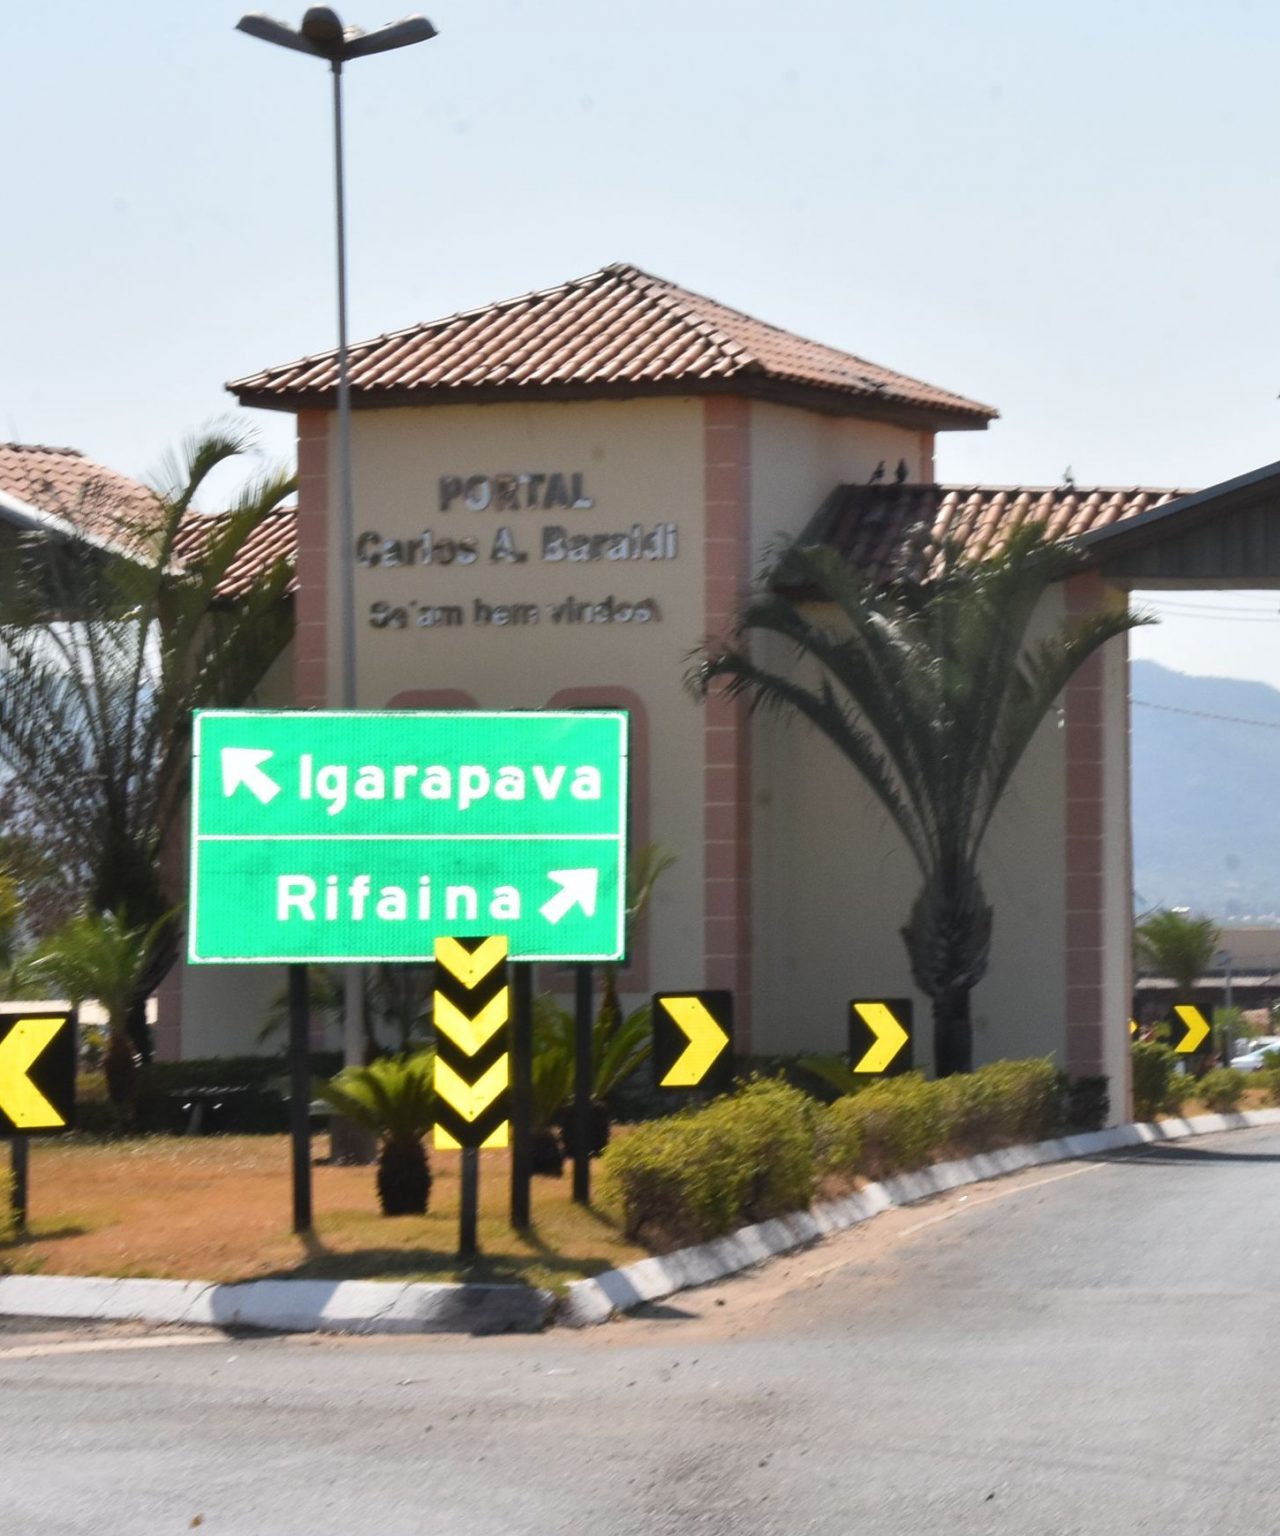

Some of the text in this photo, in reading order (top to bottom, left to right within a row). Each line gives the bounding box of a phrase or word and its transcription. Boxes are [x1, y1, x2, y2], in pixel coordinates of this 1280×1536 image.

[439, 472, 594, 512] PORTAL
[356, 529, 479, 568] Carlos
[490, 526, 527, 564] A.
[299, 753, 602, 816] Igarapava
[276, 873, 522, 922] Rifaina
